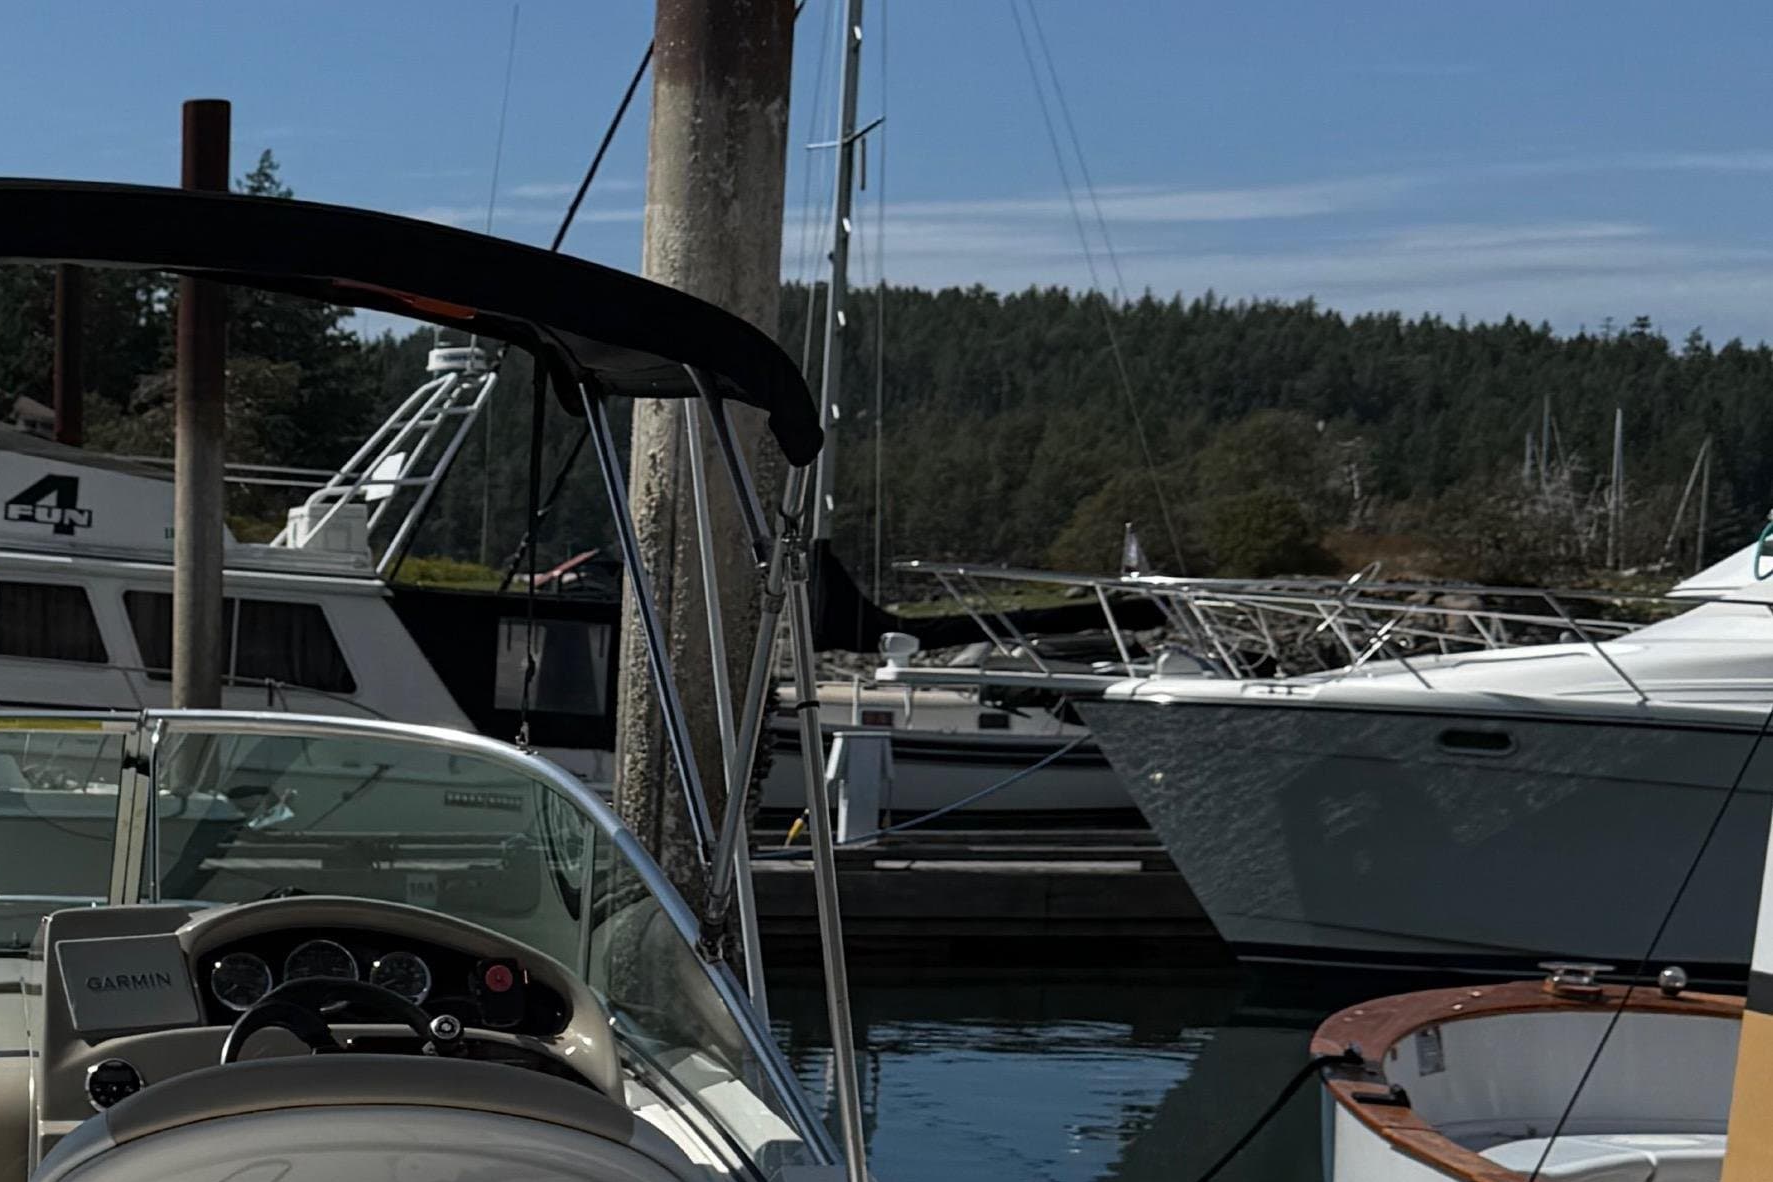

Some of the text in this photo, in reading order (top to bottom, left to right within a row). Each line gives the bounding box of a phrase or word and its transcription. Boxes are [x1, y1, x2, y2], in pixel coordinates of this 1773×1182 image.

[4, 473, 80, 536] 4
[5, 503, 92, 528] FUN
[86, 971, 172, 992] GARMIN
